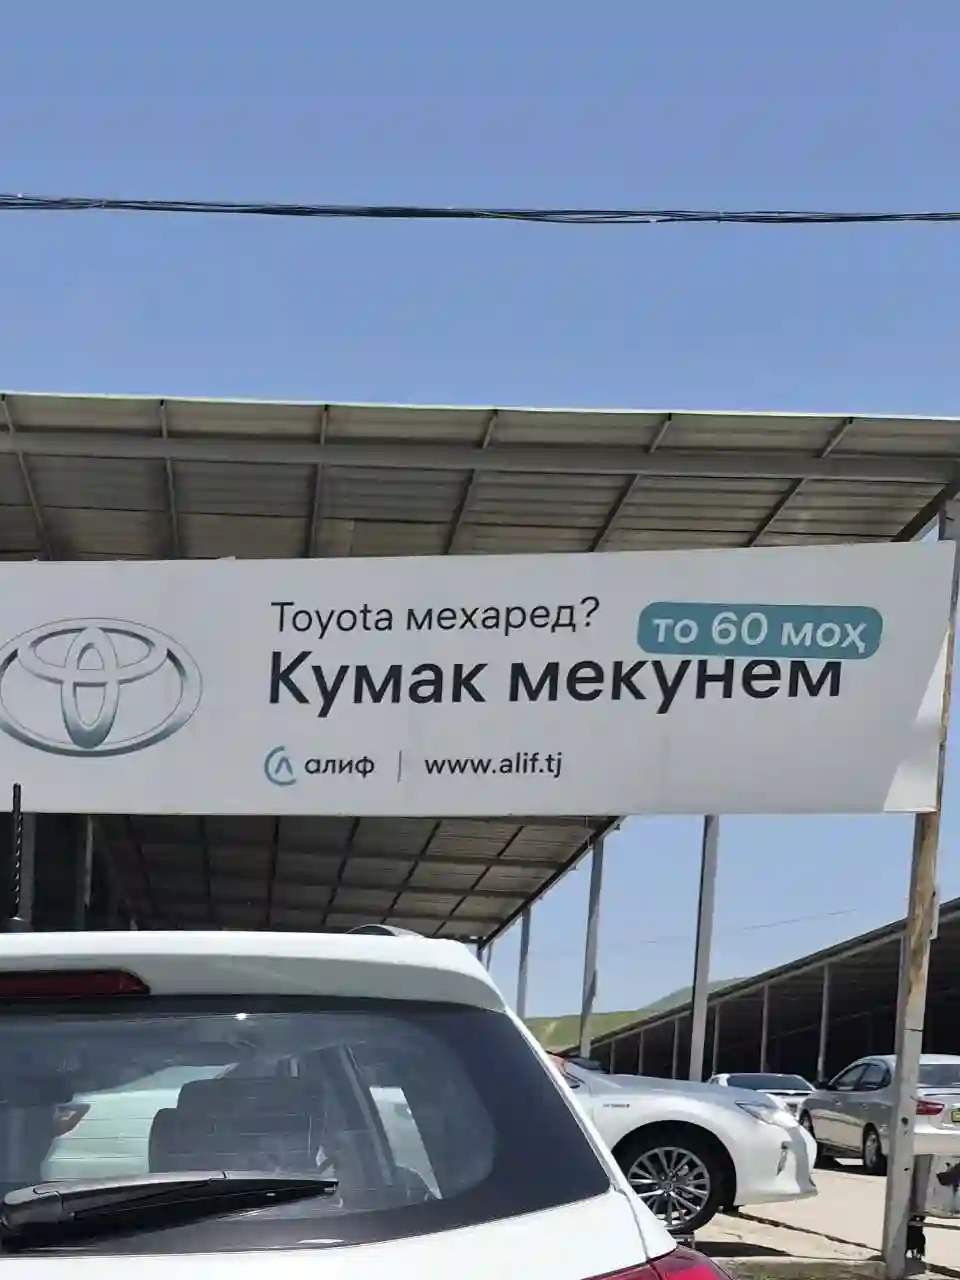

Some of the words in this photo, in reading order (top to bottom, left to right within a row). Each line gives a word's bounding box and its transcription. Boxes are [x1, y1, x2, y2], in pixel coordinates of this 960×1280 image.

[271, 601, 392, 639] Toyota
[406, 596, 600, 636] мехаред?
[651, 617, 699, 644] то
[711, 611, 768, 646] 60
[269, 650, 489, 718] Кумак
[508, 657, 843, 715] мекунем
[304, 755, 376, 778] алиф
[424, 751, 564, 779] www.alif.tj
